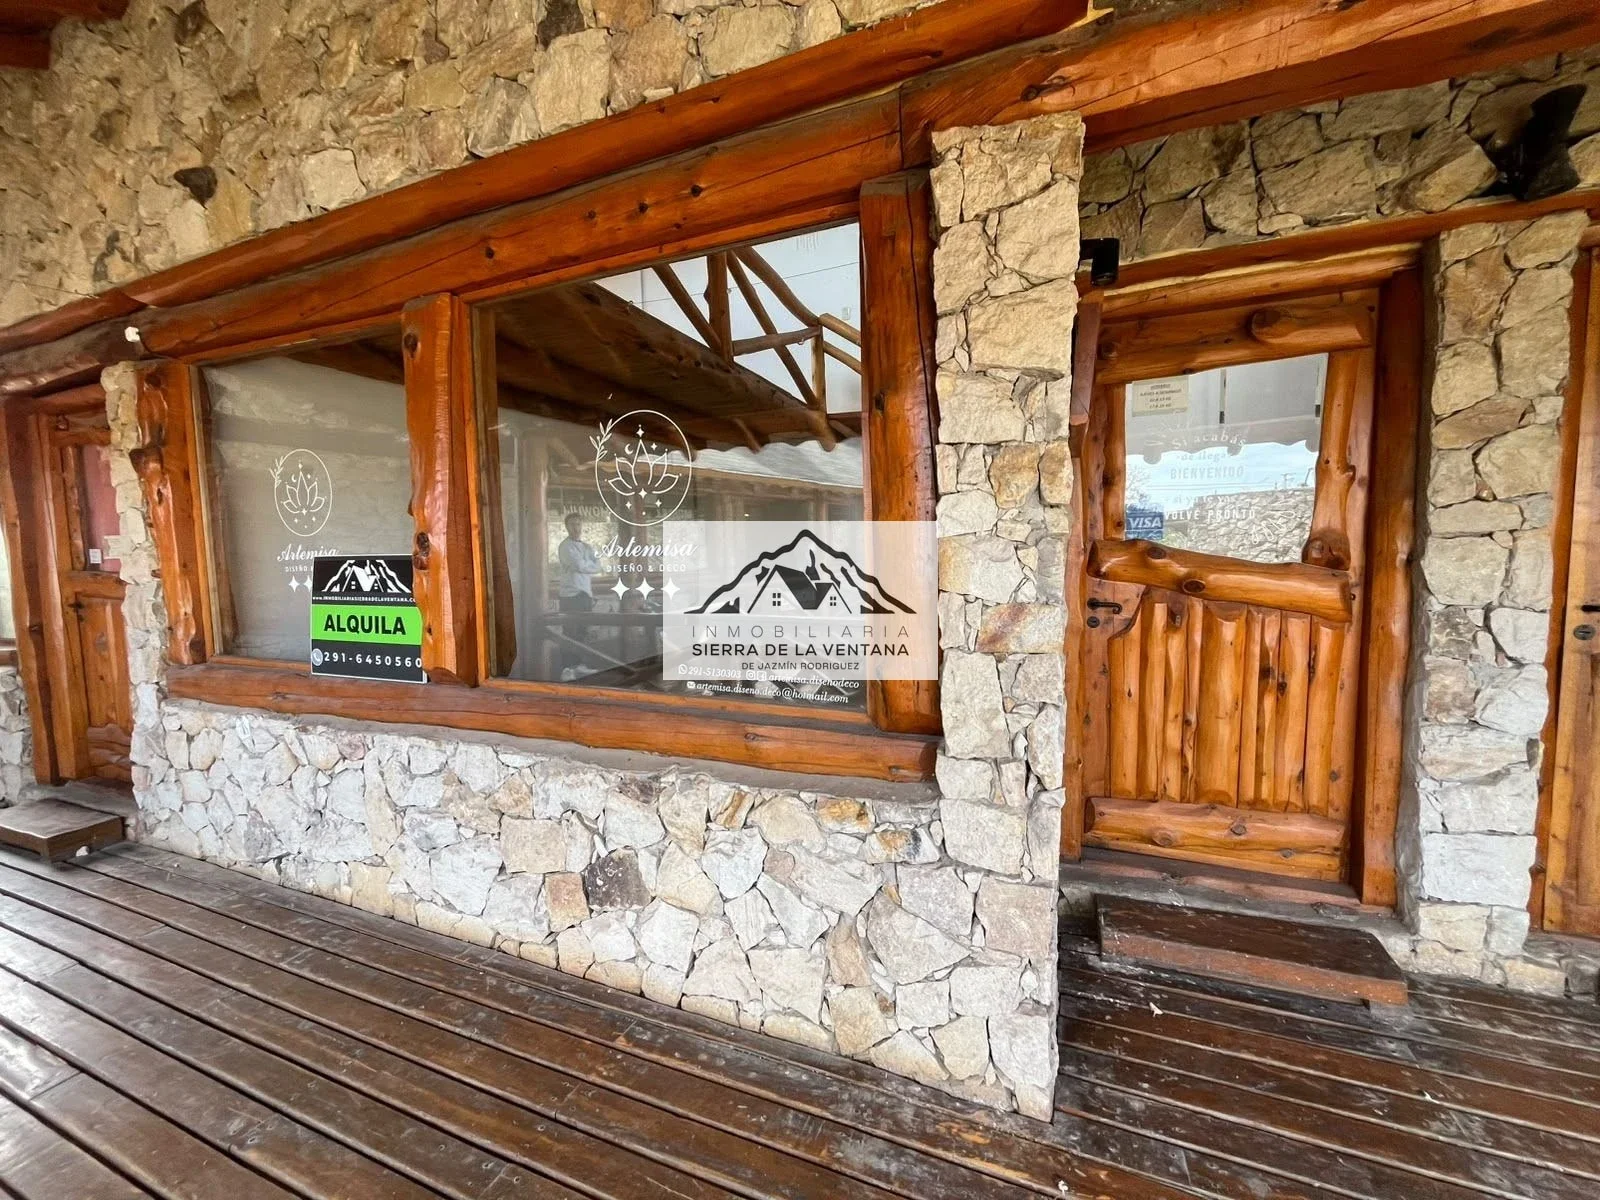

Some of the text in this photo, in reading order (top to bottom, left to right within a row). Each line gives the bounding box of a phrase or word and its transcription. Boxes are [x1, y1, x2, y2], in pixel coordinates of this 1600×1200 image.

[1170, 465, 1245, 480] BIENVENIDO
[1127, 516, 1162, 528] VISA
[1206, 508, 1256, 521] PRONTO
[276, 543, 339, 563] Artemisa
[594, 534, 699, 559] Artemisa
[606, 562, 687, 573] DISEÑO & DECO
[324, 613, 406, 636] ALQUILA
[323, 651, 422, 668] 291-6450560
[687, 665, 742, 680] 291-5130303
